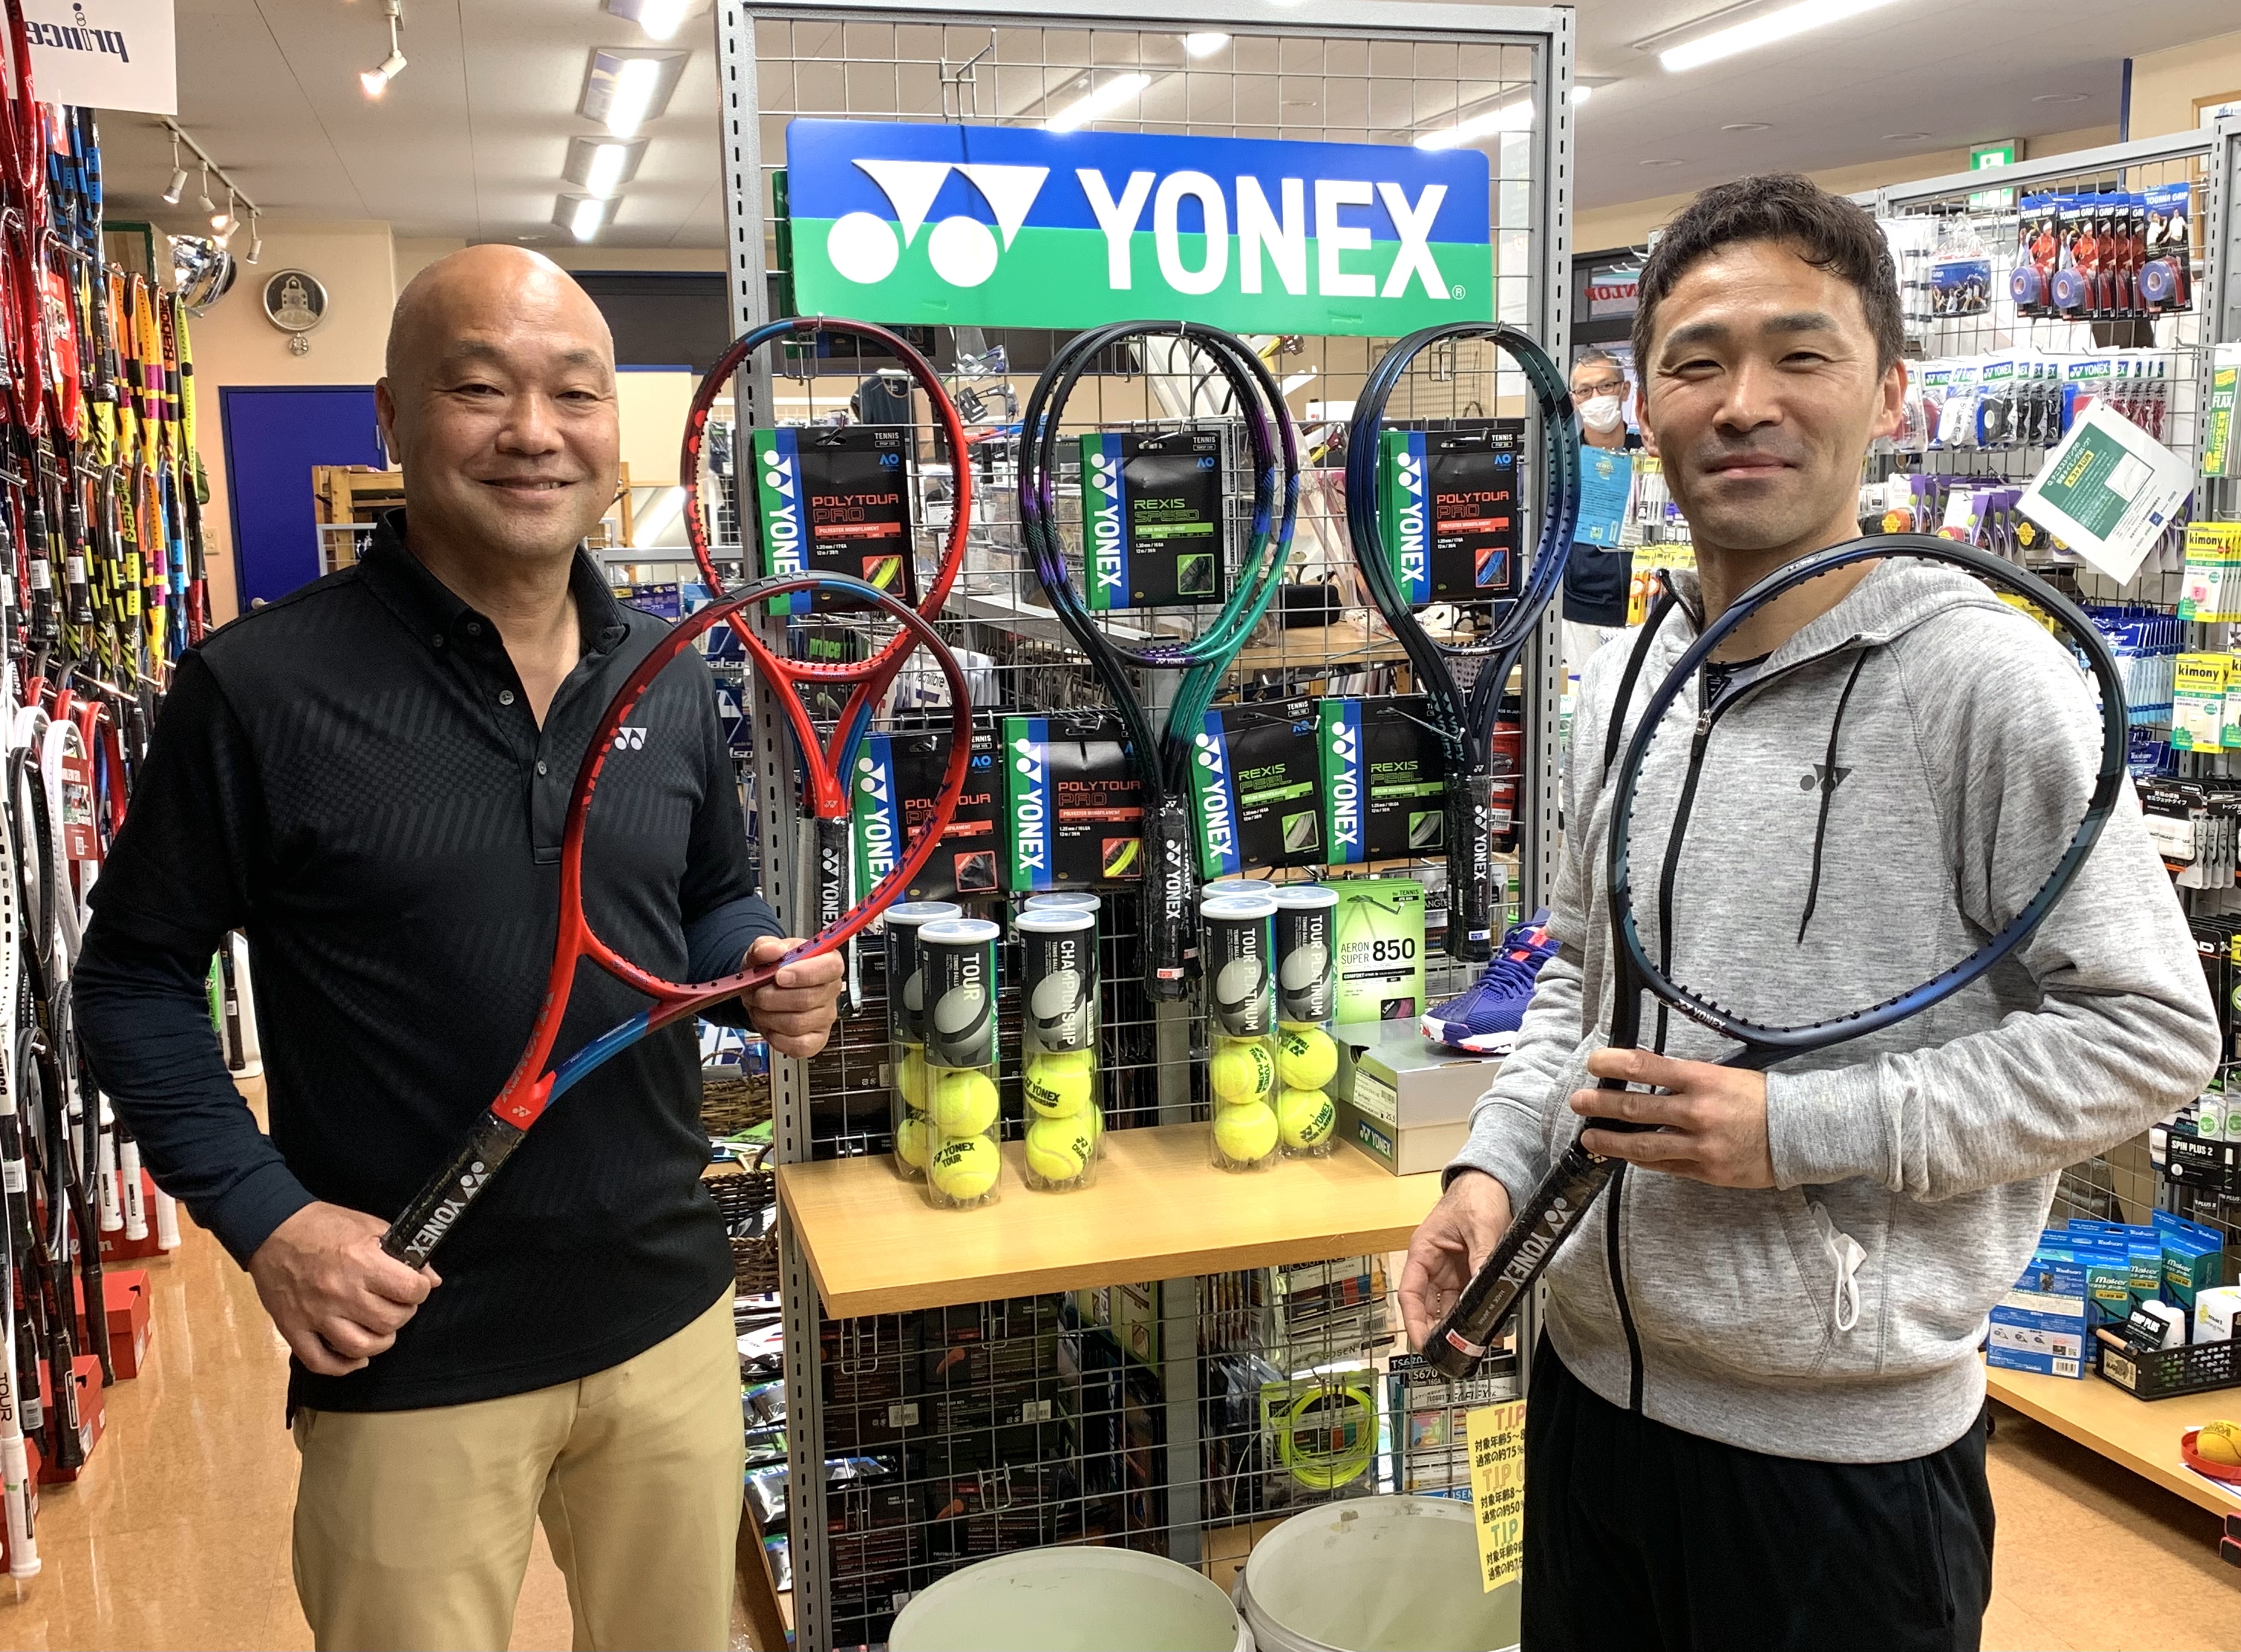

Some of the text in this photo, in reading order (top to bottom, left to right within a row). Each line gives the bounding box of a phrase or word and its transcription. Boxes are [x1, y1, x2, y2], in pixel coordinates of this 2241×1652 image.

[2146, 191, 2188, 205] TOURNA GRIP
[2042, 206, 2056, 217] GRIP
[2081, 208, 2095, 217] GRIP
[1074, 169, 1451, 300] YONEX
[1994, 363, 2012, 376] YONEX
[2085, 363, 2108, 375] YONEX
[2212, 395, 2233, 408] FLAX
[812, 494, 899, 507] POLYTOUR
[1134, 498, 1185, 510] REXIS
[1437, 491, 1509, 504] POLYTOUR
[813, 507, 865, 523] PRO
[1135, 509, 1199, 523] SPEED
[1437, 504, 1479, 519] PRO
[769, 504, 801, 577] YONE
[1094, 504, 1122, 588] YONEX
[1399, 502, 1424, 583] YONEX
[2190, 533, 2223, 545] kimony
[2178, 664, 2219, 681] kimony
[1287, 701, 1308, 710] TENNIS
[971, 735, 991, 743] ENNIS
[1238, 763, 1286, 781] REXIS
[1371, 761, 1418, 772] REXIS
[1239, 775, 1293, 793] FEEL
[1371, 771, 1423, 784] FEEL
[1058, 780, 1141, 792] POLYTOUR
[1058, 792, 1107, 807] PRO
[1334, 768, 1357, 846] YONEX
[2147, 795, 2188, 806] セミウェットタイプ
[1202, 778, 1233, 859] YONEX
[1018, 788, 1044, 870] YONEX
[1474, 836, 1487, 881] YONEX
[1166, 871, 1180, 919] YONEX
[1341, 942, 1369, 953] AERON
[1373, 938, 1415, 961] 850
[1311, 915, 1324, 1016] TOUR PLATINUM
[1341, 954, 1369, 964] SUPER
[962, 952, 980, 1001] TOUR
[1242, 928, 1259, 1031] TOUR PLATINUM
[1061, 940, 1076, 1045] CHAMPIONSHIP
[1693, 1007, 1726, 1029] YONEX
[1250, 1048, 1260, 1063] TOUR
[1033, 1083, 1060, 1103] YONEX
[1312, 1101, 1331, 1127] YONEX
[1386, 1112, 1396, 1123] 25.5
[1304, 1131, 1319, 1144] TOUR
[1370, 1131, 1392, 1158] YONEX
[944, 1142, 975, 1158] YONEX
[2171, 1140, 2213, 1156] SPIN PLUS 2
[942, 1154, 961, 1168] TOUR
[407, 1199, 466, 1257] YONEX
[1499, 1231, 1553, 1289] YONEX
[2168, 1259, 2192, 1273] Maker
[2130, 1265, 2160, 1275] Maker
[2095, 1276, 2127, 1286] Maker
[2131, 1311, 2160, 1332] GRIP PLUS
[1323, 1345, 1356, 1360] GOSEN
